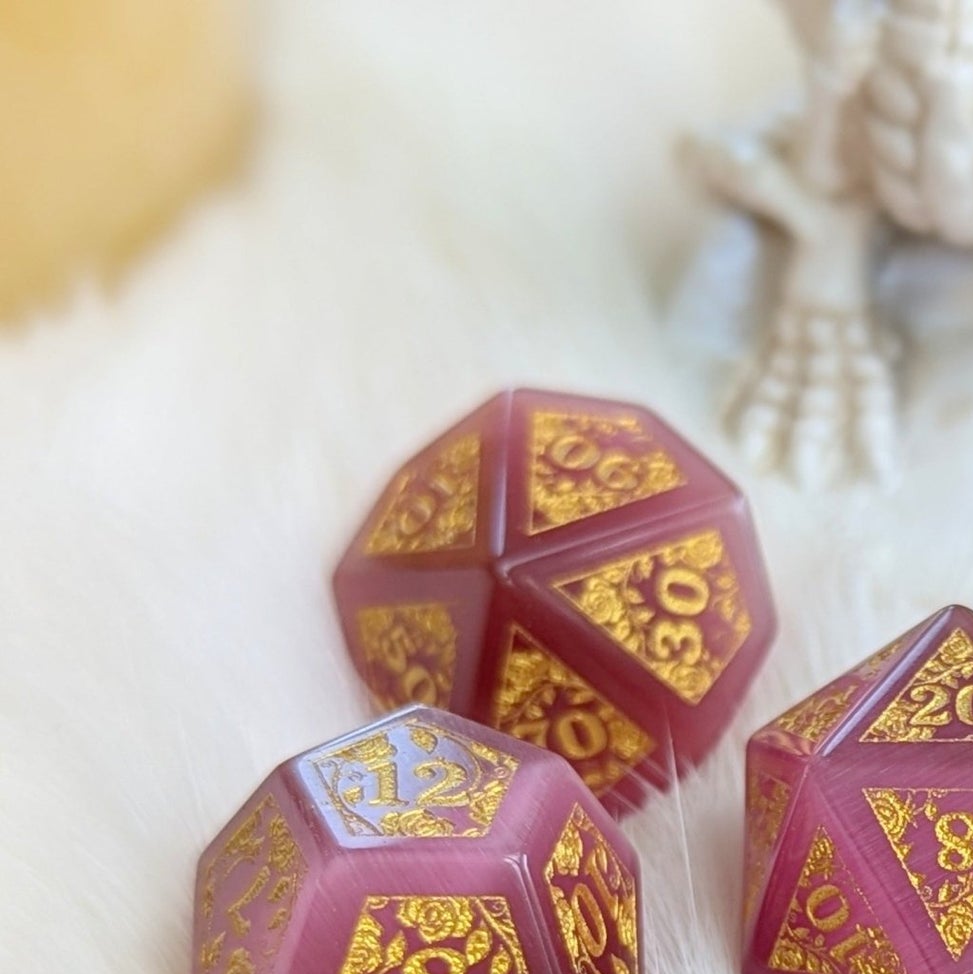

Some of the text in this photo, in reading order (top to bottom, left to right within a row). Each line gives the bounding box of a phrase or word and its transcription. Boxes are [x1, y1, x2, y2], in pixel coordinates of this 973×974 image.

[648, 567, 712, 665] 30
[367, 758, 472, 807] 12
[571, 849, 619, 957] 10
[806, 884, 872, 962] 10
